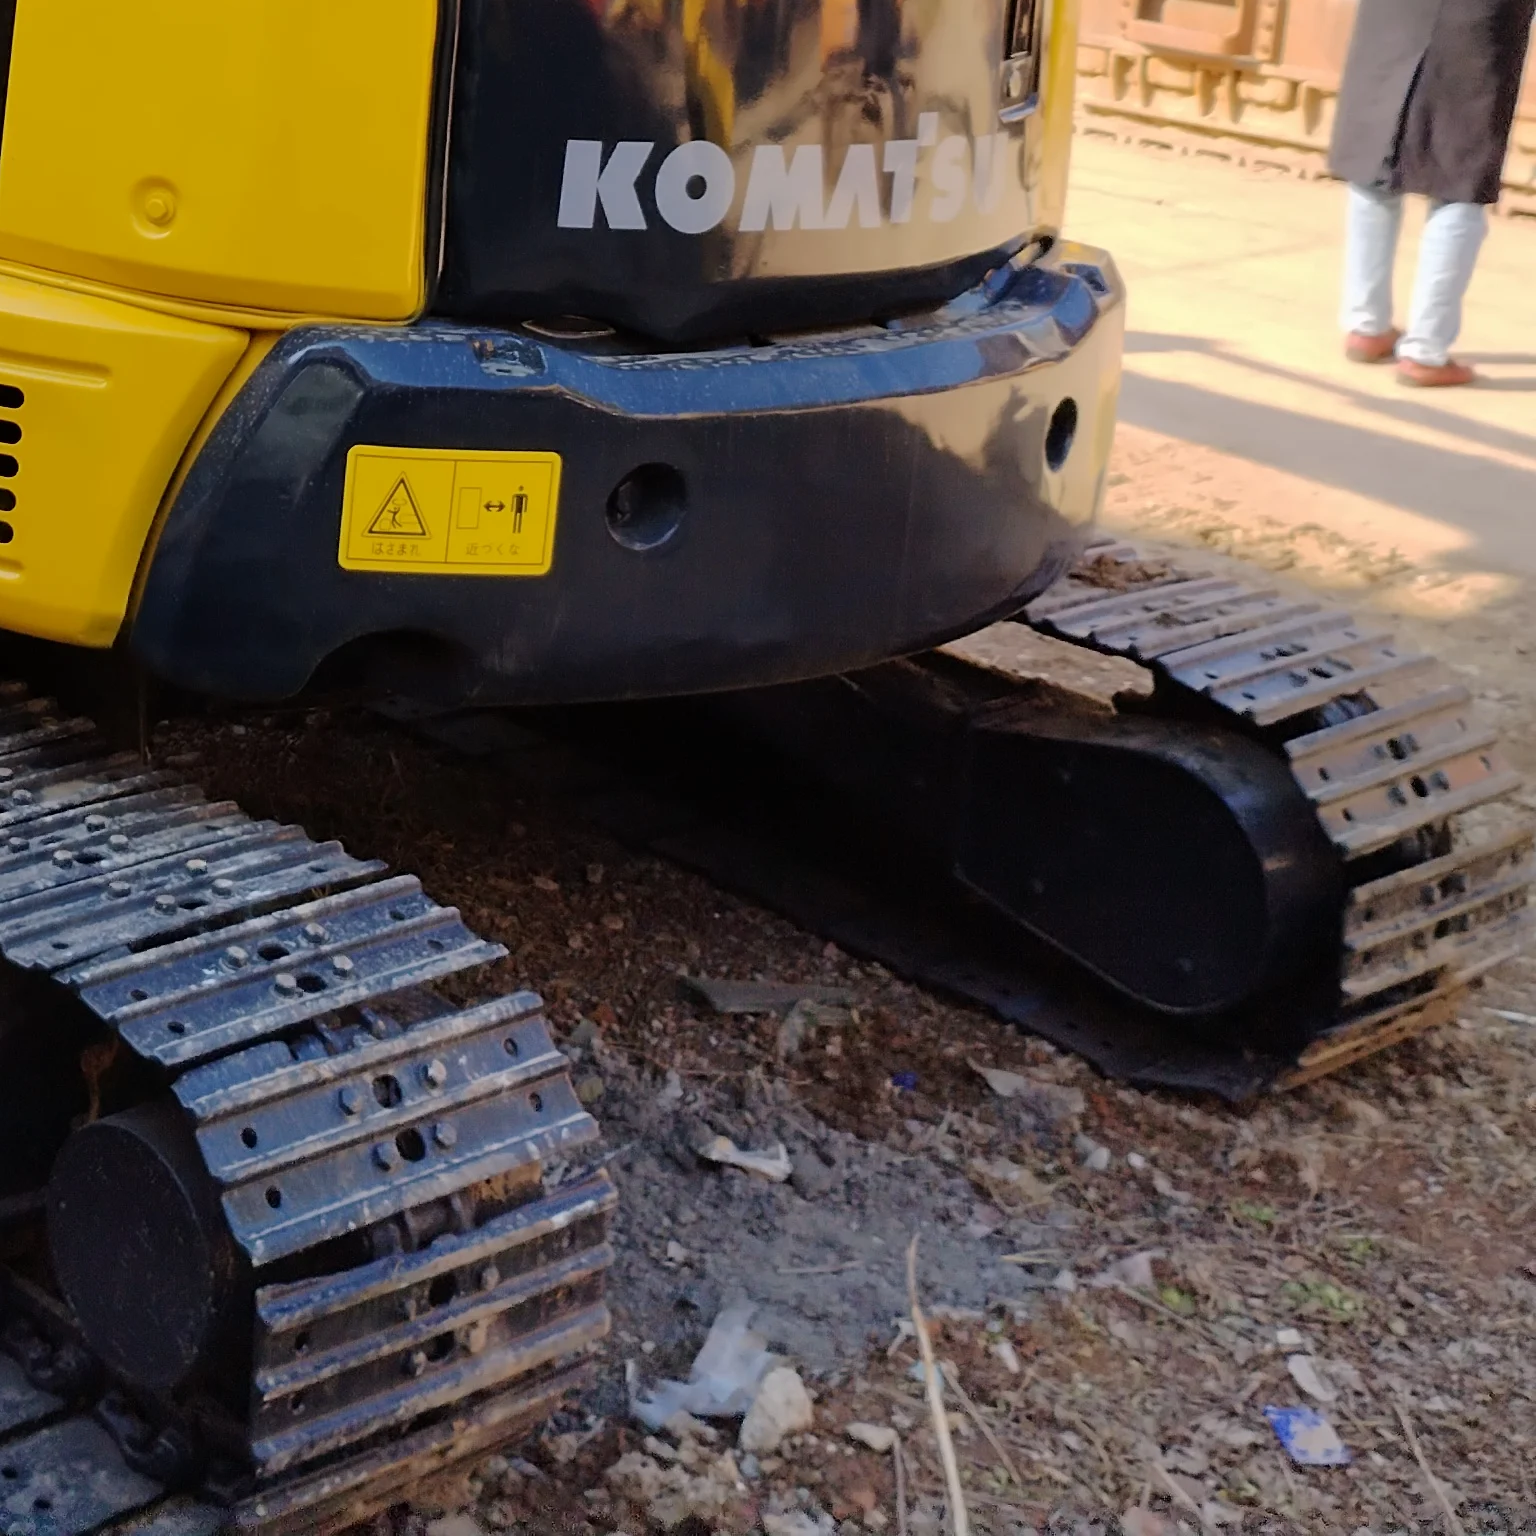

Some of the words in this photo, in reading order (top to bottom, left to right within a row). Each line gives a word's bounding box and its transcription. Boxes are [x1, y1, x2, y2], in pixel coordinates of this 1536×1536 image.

[557, 112, 1010, 234] KOMATSU
[371, 541, 421, 556] はさまれ
